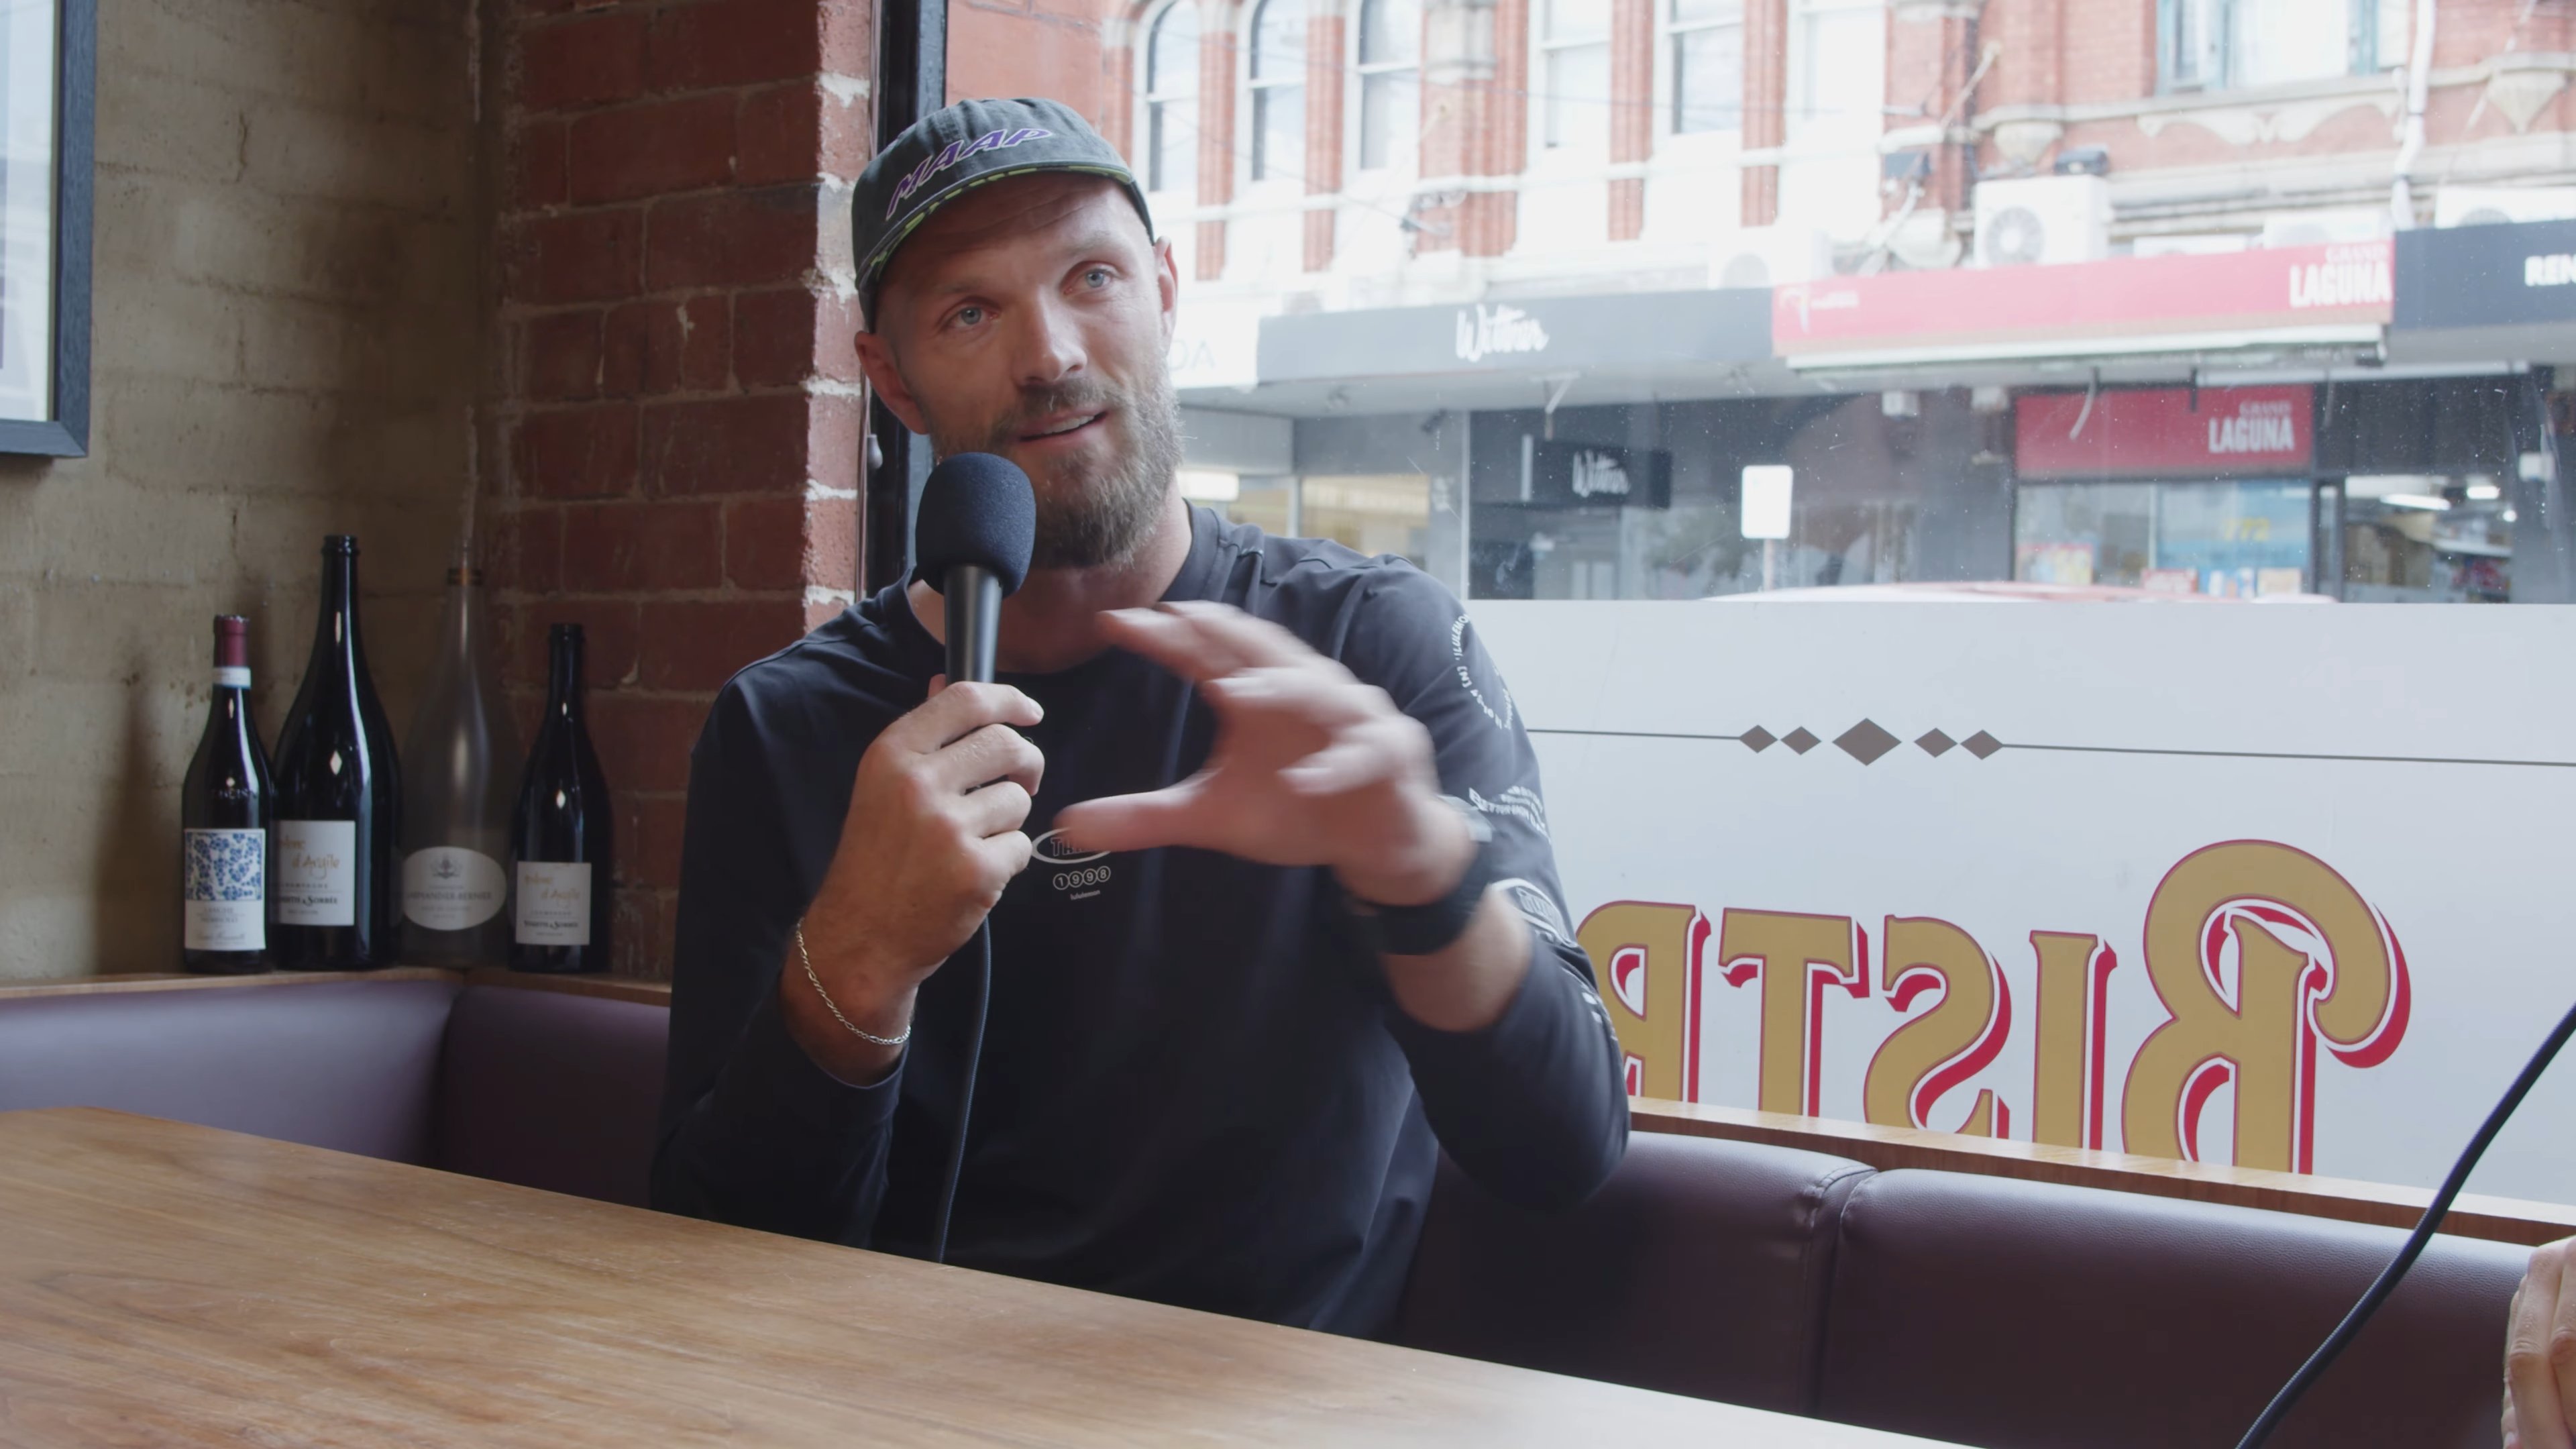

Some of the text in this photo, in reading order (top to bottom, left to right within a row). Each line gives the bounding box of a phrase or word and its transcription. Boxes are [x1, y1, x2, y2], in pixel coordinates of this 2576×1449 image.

[885, 128, 1053, 221] MAAP
[2290, 262, 2393, 307] LAGUNA
[2208, 416, 2294, 453] LAGUNA
[1055, 867, 1110, 889] 1998
